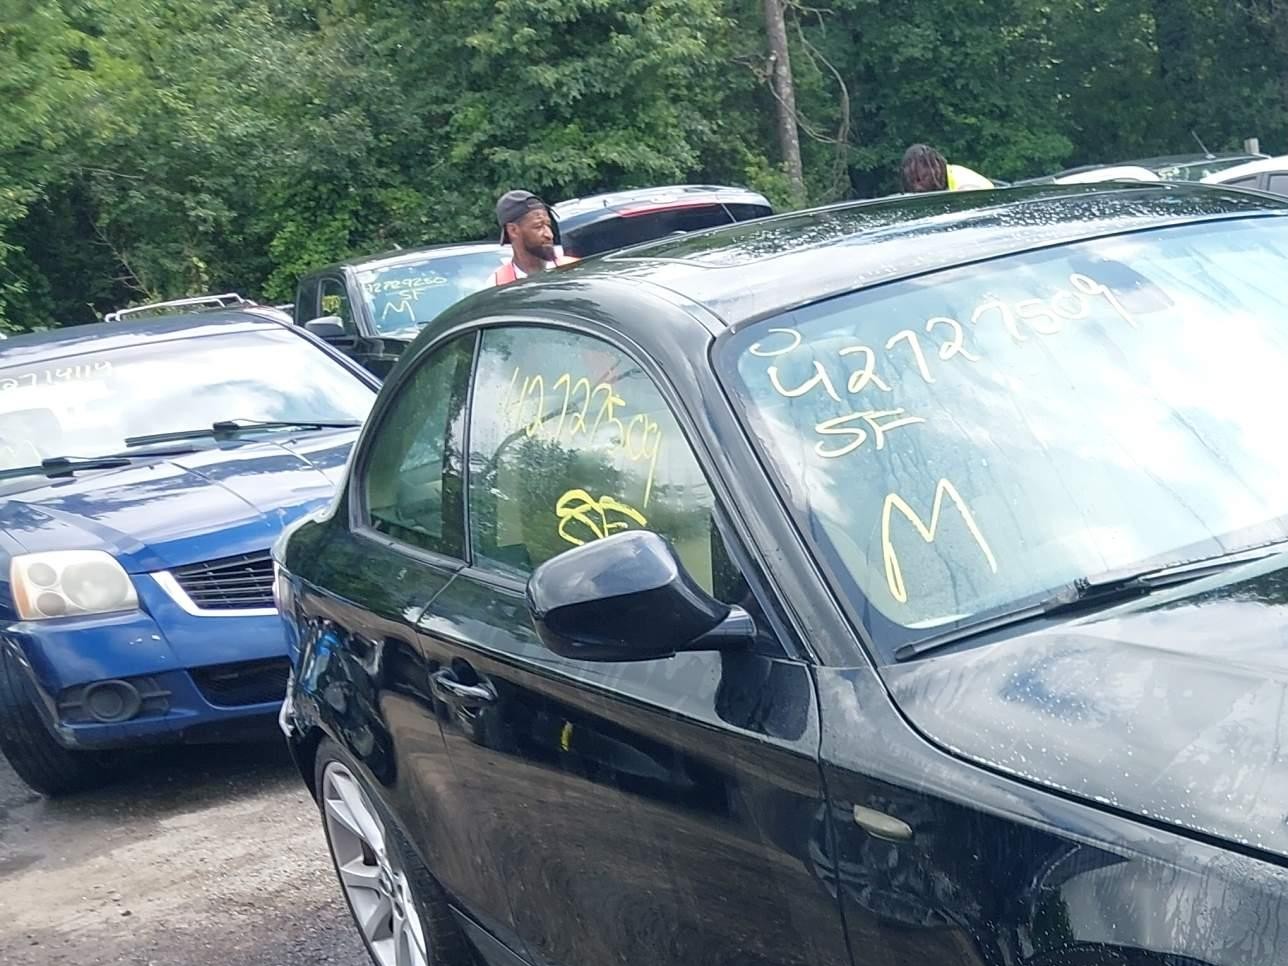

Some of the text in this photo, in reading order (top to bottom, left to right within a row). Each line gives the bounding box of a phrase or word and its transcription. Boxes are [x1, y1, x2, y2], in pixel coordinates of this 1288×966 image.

[381, 300, 416, 322] M
[767, 272, 1138, 402] 42727509
[815, 406, 927, 459] SF
[881, 478, 998, 604] M
